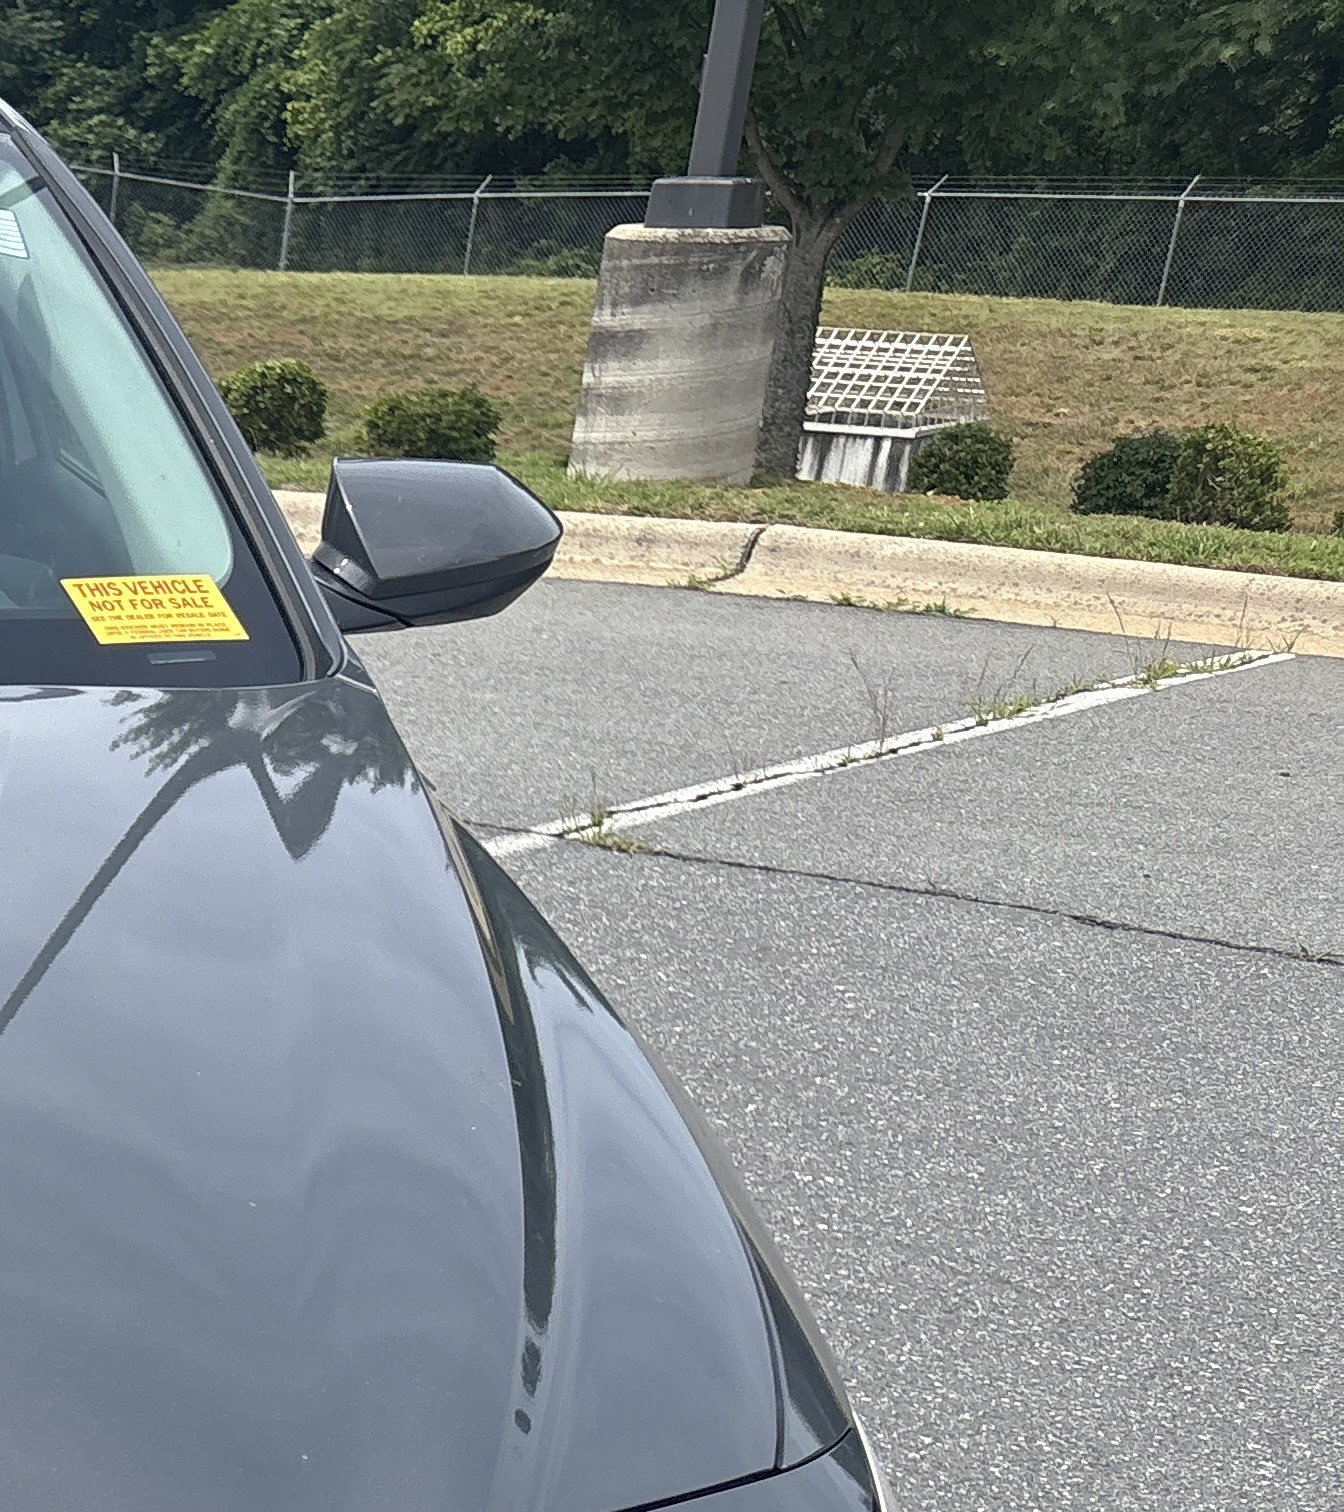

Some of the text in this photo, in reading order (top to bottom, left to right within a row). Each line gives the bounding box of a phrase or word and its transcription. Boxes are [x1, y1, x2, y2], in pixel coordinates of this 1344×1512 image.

[72, 579, 209, 598] THIS VEHICLE
[88, 596, 214, 612] NOT FOR SALE
